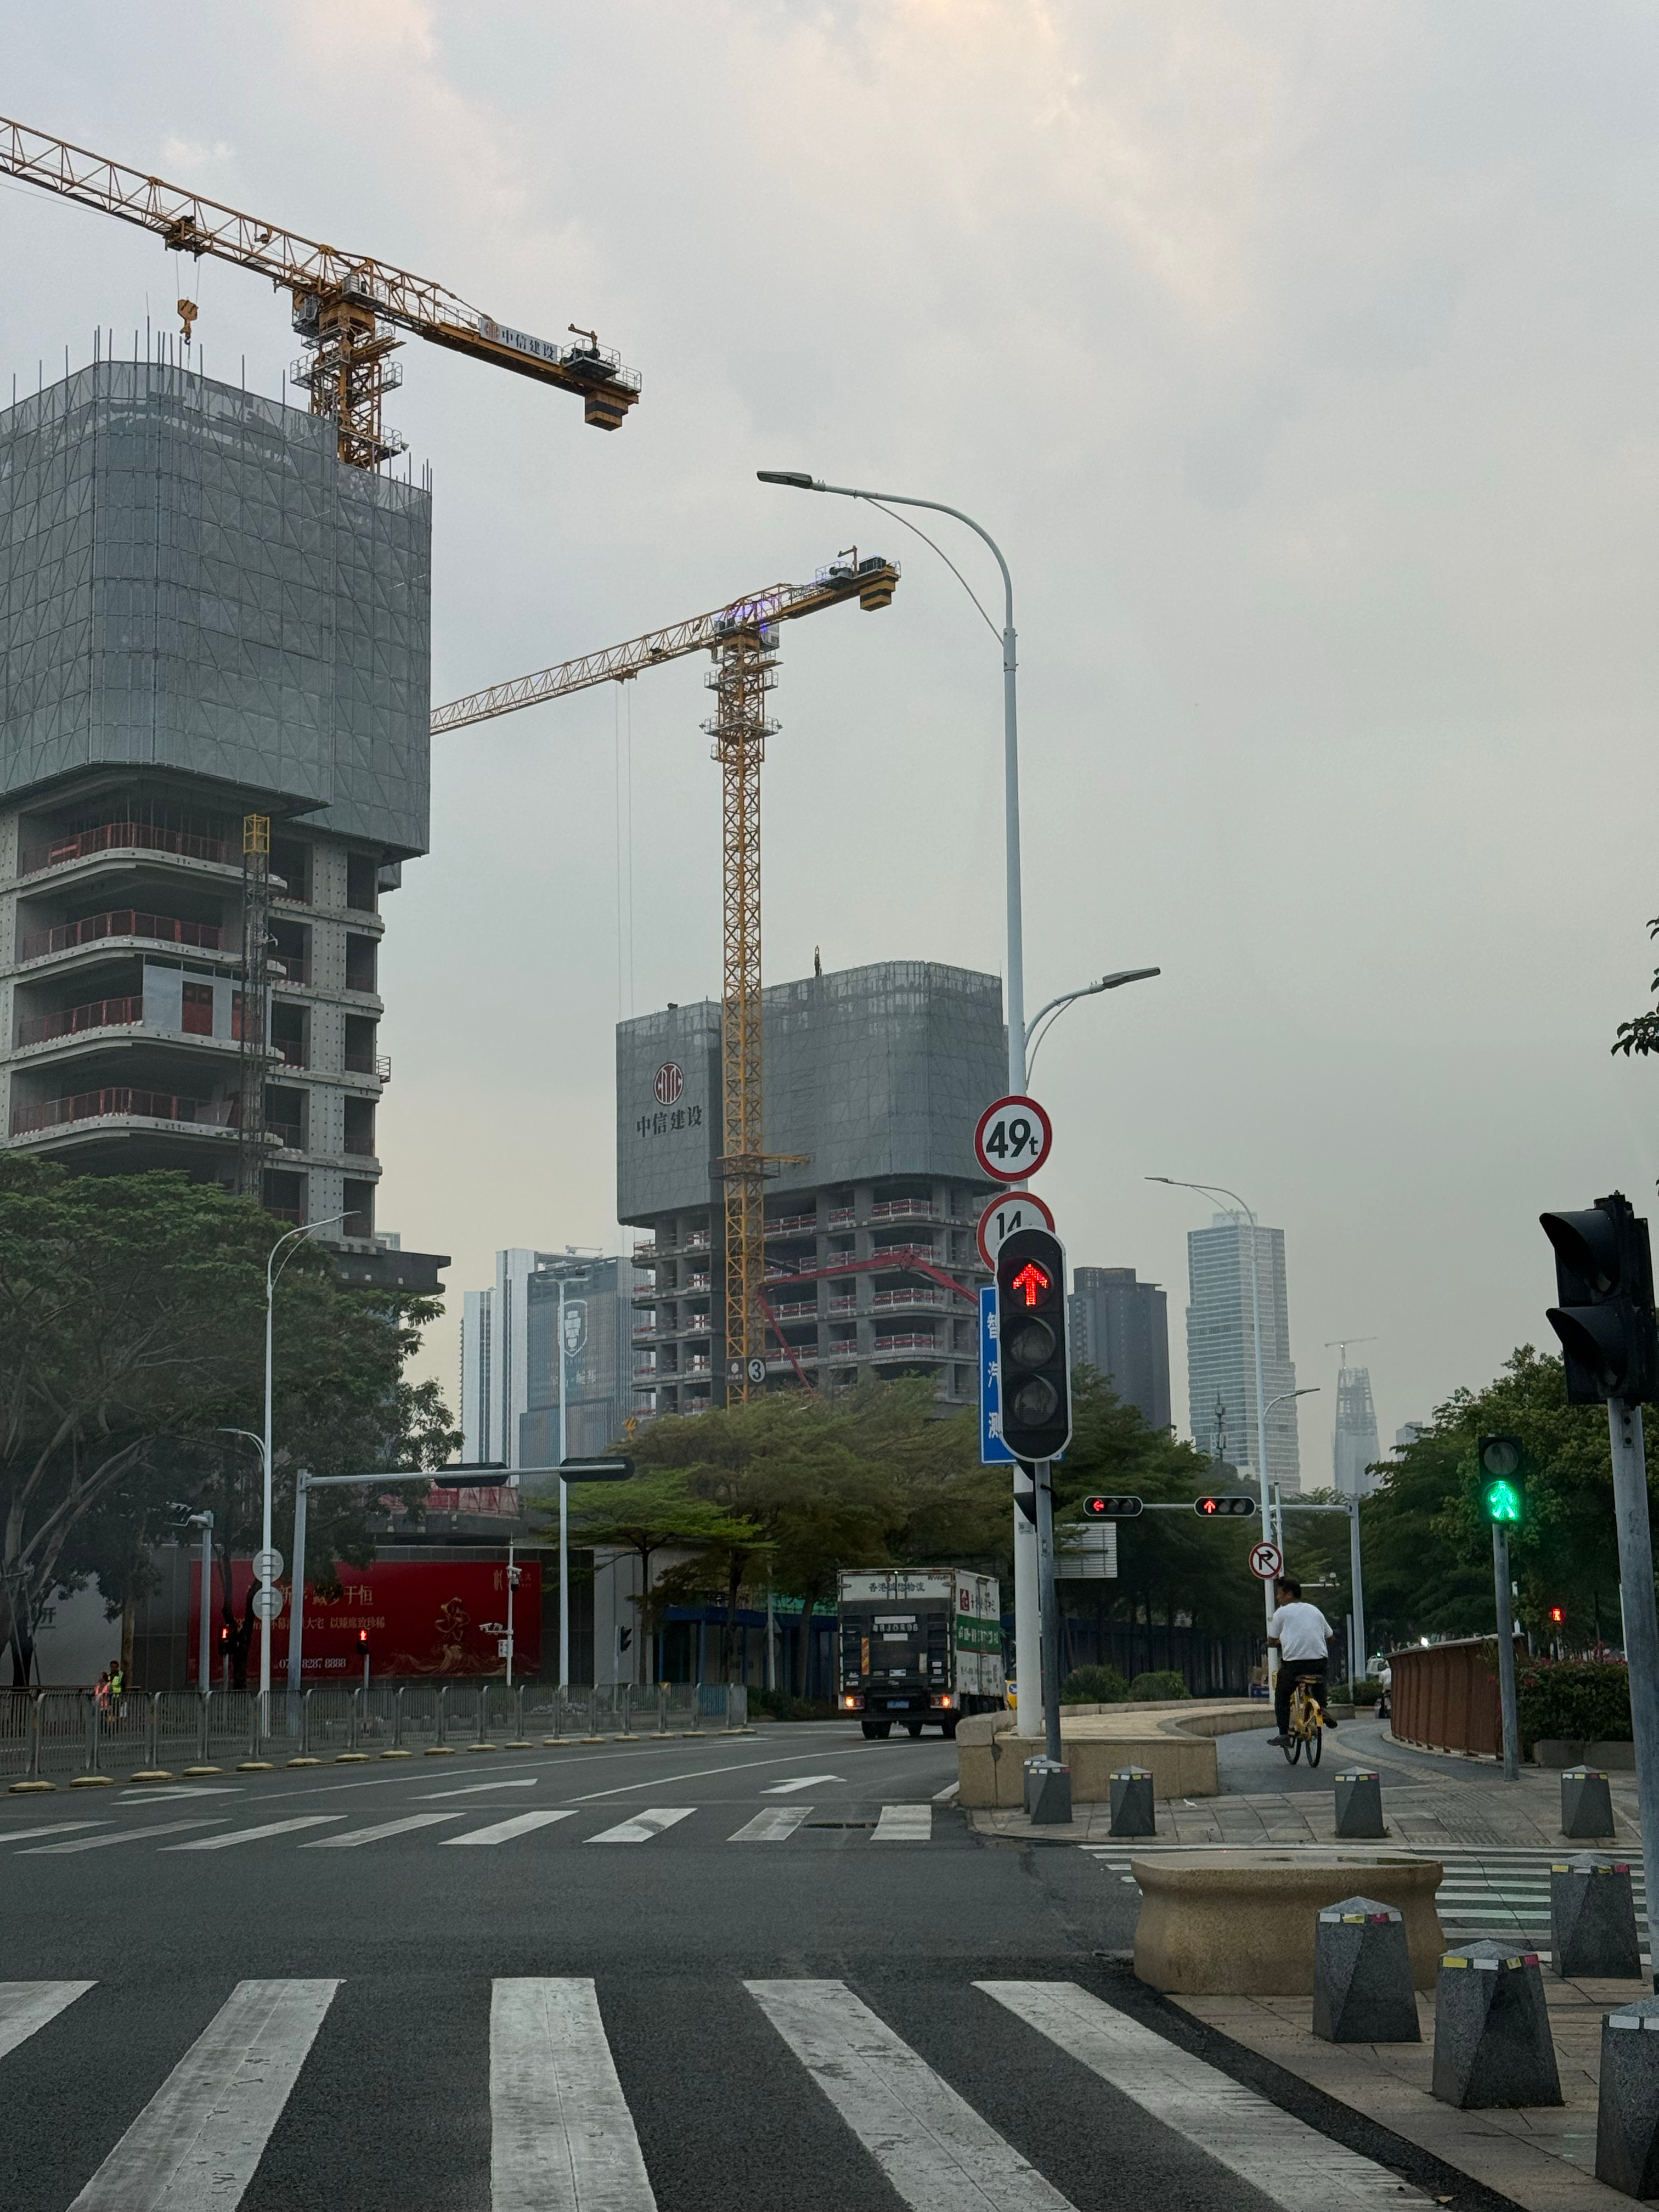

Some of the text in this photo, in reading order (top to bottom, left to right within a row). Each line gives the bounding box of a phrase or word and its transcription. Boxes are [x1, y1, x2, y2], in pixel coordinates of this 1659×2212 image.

[502, 330, 555, 360] 中信建设
[636, 1105, 702, 1138] 中信建设
[986, 1118, 1039, 1159] 49t
[752, 1362, 761, 1380] 3
[302, 1658, 323, 1669] 8287
[325, 1657, 346, 1668] 8888
